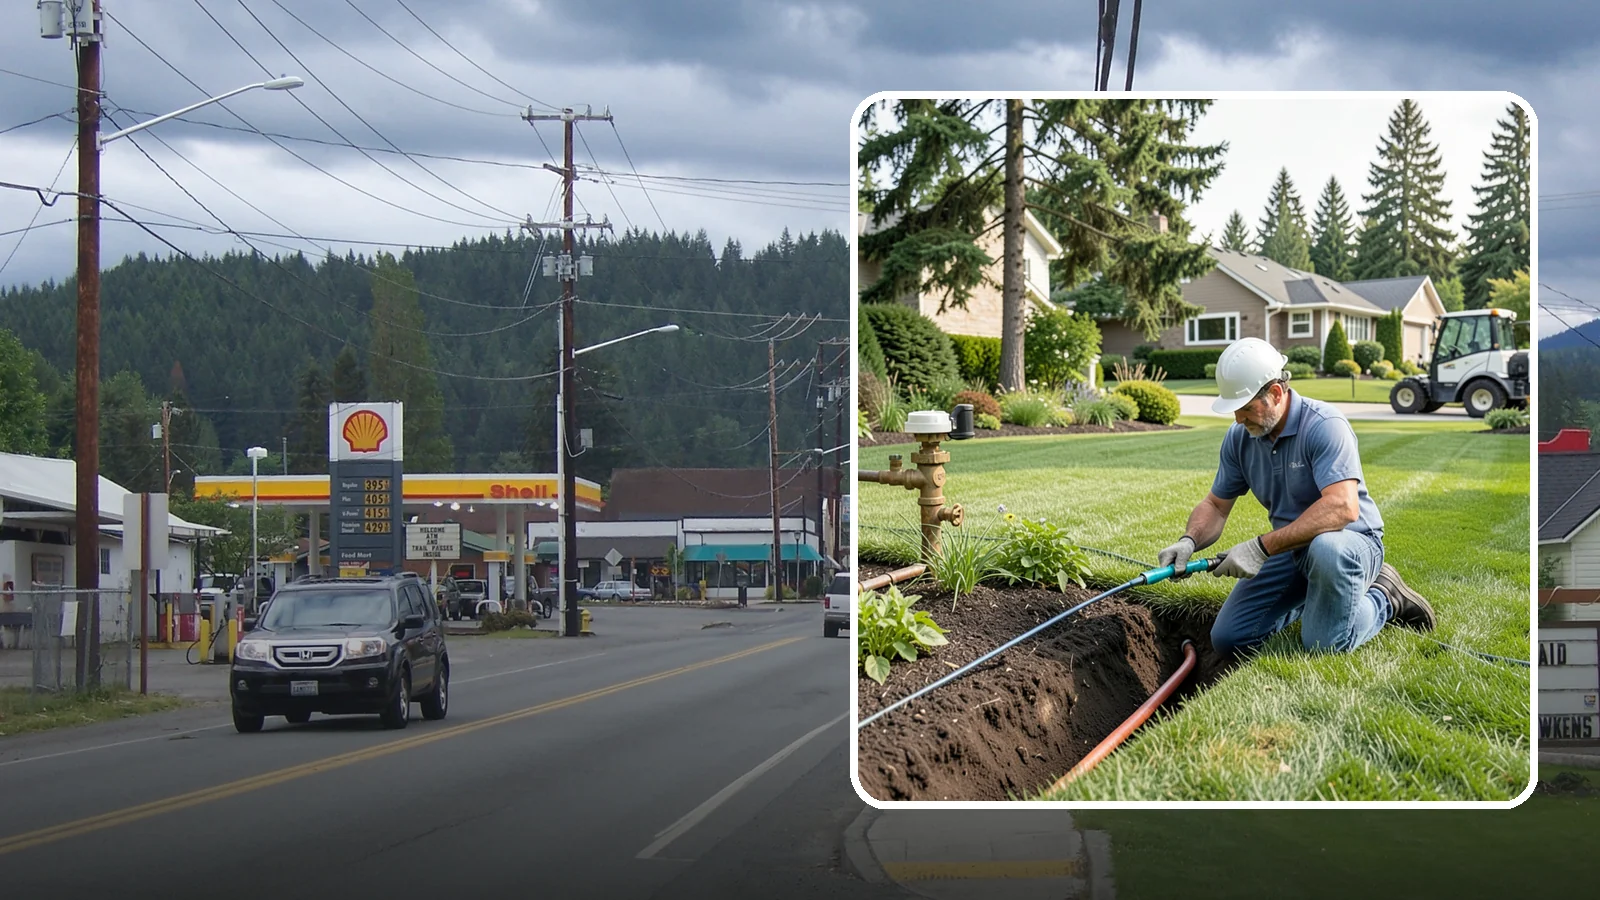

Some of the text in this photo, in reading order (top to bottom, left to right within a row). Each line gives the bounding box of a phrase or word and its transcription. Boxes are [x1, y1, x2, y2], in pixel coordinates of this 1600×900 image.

[366, 480, 383, 490] 395
[490, 484, 547, 499] Shell
[366, 494, 383, 504] 405
[366, 508, 383, 518] 415
[366, 522, 383, 532] 429
